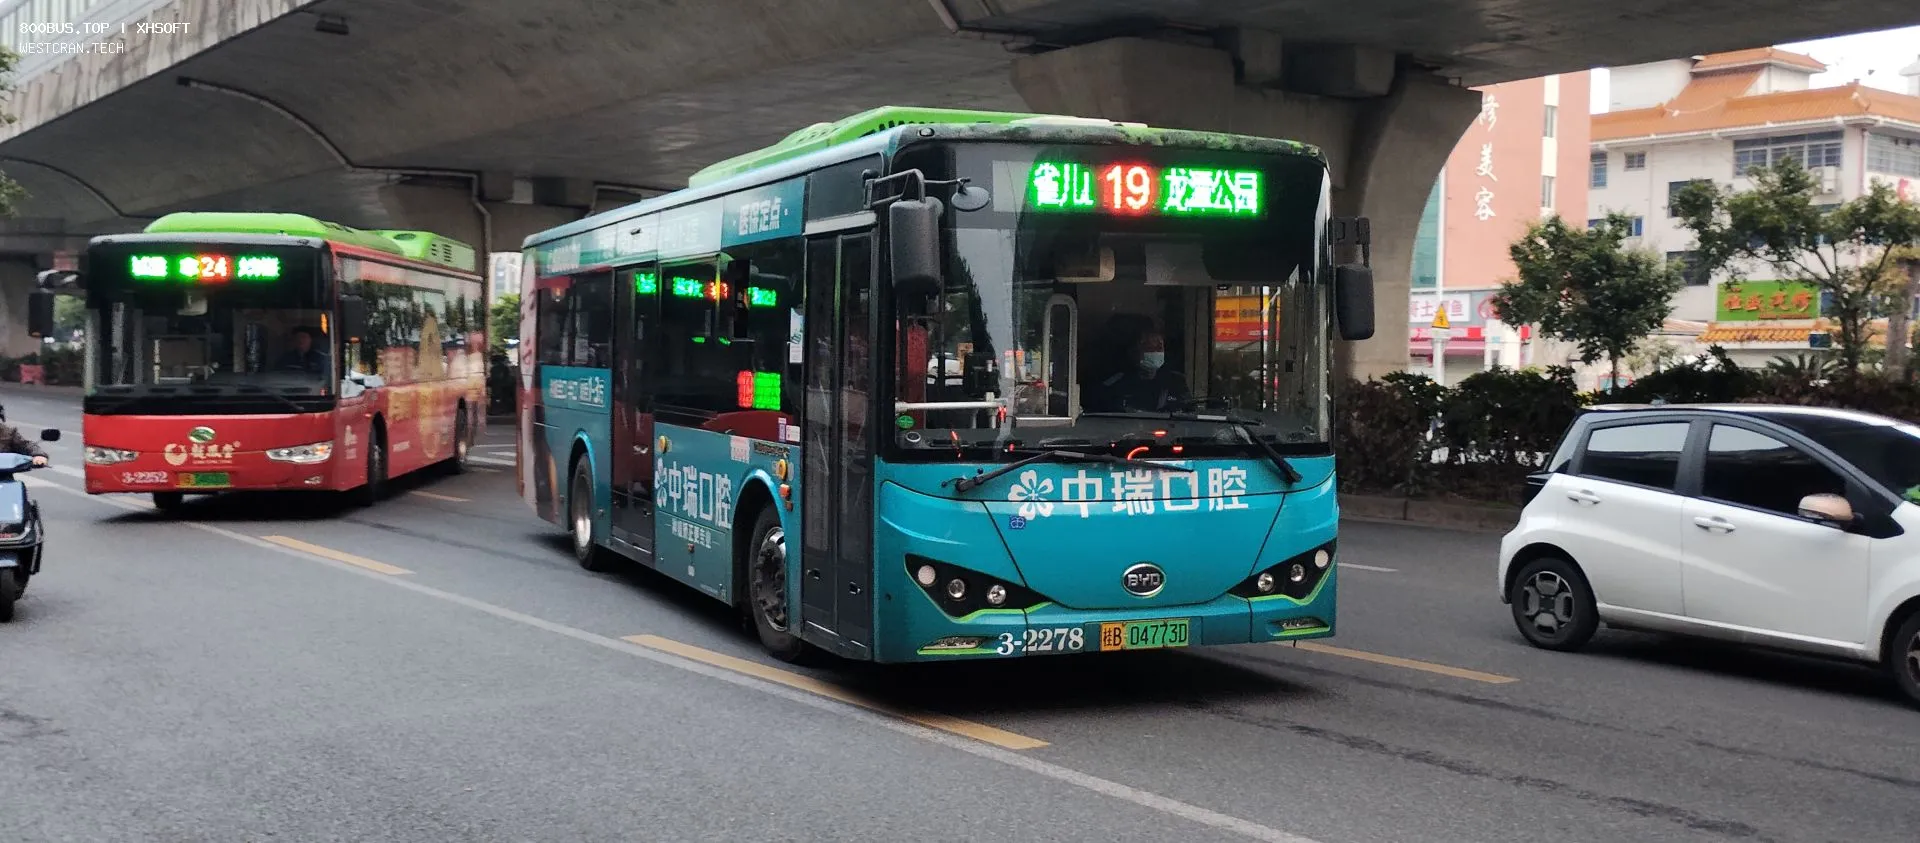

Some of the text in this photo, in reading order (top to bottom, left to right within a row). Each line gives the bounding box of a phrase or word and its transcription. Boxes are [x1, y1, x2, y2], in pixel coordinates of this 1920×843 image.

[1106, 165, 1150, 210] 19
[1164, 167, 1257, 213] 龙潭公园
[201, 256, 226, 278] 24
[122, 471, 168, 483] 3-2252
[668, 461, 732, 529] 中瑞口腔
[1061, 466, 1249, 518] 中瑞口腔
[1127, 572, 1161, 587] BYD
[997, 626, 1084, 656] 3-2278
[1102, 622, 1188, 648] 桂B 04773D
